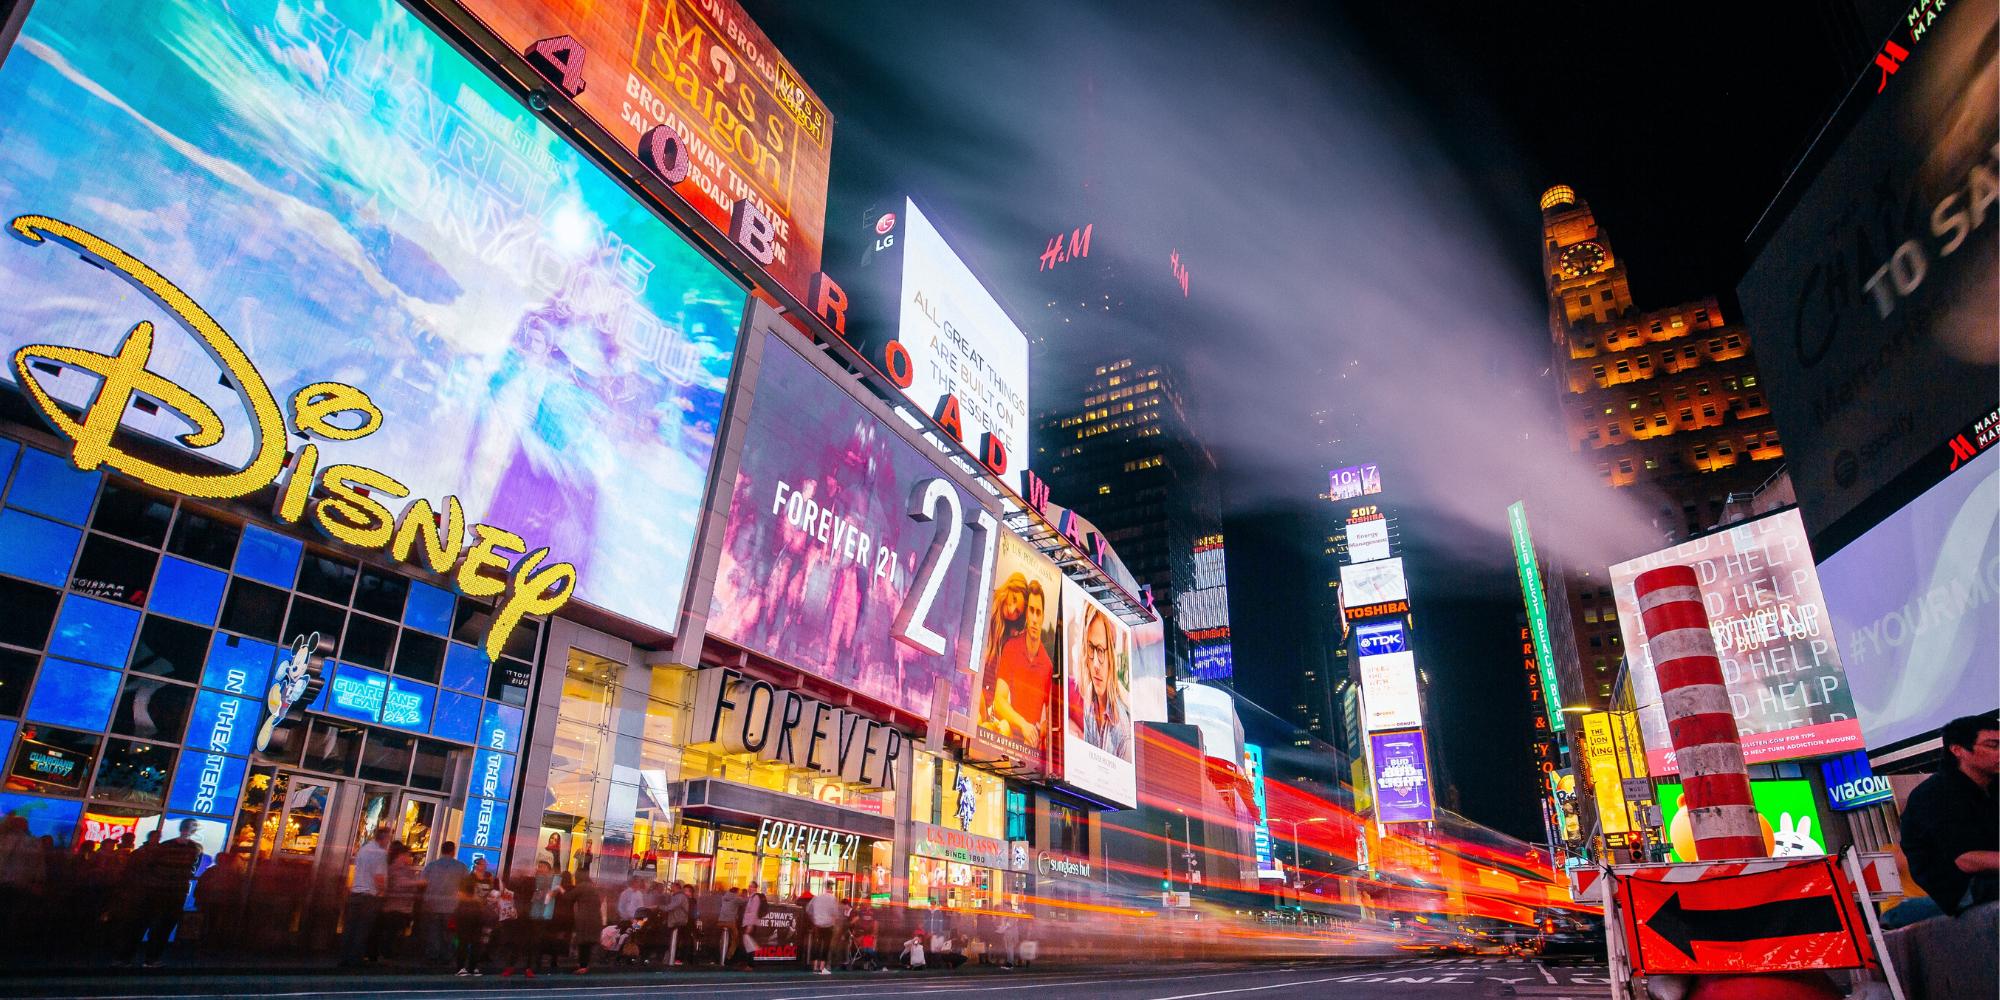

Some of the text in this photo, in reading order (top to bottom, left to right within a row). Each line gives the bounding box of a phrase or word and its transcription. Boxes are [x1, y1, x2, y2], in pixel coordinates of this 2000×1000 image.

[626, 72, 726, 178] BROADWAY
[651, 31, 782, 191] Saigon
[876, 234, 894, 252] LG
[1040, 224, 1093, 272] H&M
[1170, 248, 1189, 298] H&M
[914, 290, 1026, 417] ALL GREAT THINGS
[929, 335, 1014, 430] ARE BUILT ON
[930, 360, 1013, 454] THE ESSENCE
[1332, 465, 1377, 486] 10:17
[772, 480, 899, 584] FOREVER 21
[1346, 512, 1386, 526] TOSHIBA
[1351, 505, 1377, 518] 2017
[894, 478, 998, 674] 21
[1724, 535, 1800, 579] HELP
[1345, 602, 1409, 619] TOSHIBA
[1732, 569, 1809, 611] HELP
[1369, 634, 1401, 647] TDK
[1525, 567, 1539, 615] BEST
[1536, 618, 1555, 681] BEACH
[1549, 683, 1564, 722] BAR
[1748, 639, 1829, 677] HELP
[1521, 628, 1540, 702] ERNST
[1535, 716, 1546, 729] &
[1757, 675, 1840, 710] HELP
[193, 669, 247, 815] IN THEATERS
[489, 729, 506, 750] IN
[705, 667, 900, 792] FOREVER
[979, 729, 995, 742] LIVE
[996, 736, 1041, 759] AUTHENTICALLY
[1590, 736, 1608, 746] LION
[1750, 748, 1767, 756] HELP
[1767, 746, 1786, 754] TURN
[1787, 740, 1825, 750] ADDICTION
[1591, 746, 1613, 758] KING
[473, 755, 502, 848] THEATERS
[757, 818, 860, 861] FOREVER 21
[945, 850, 986, 864] SINCE 1890
[947, 832, 974, 849] POLO
[1050, 857, 1090, 878] sunglass hut
